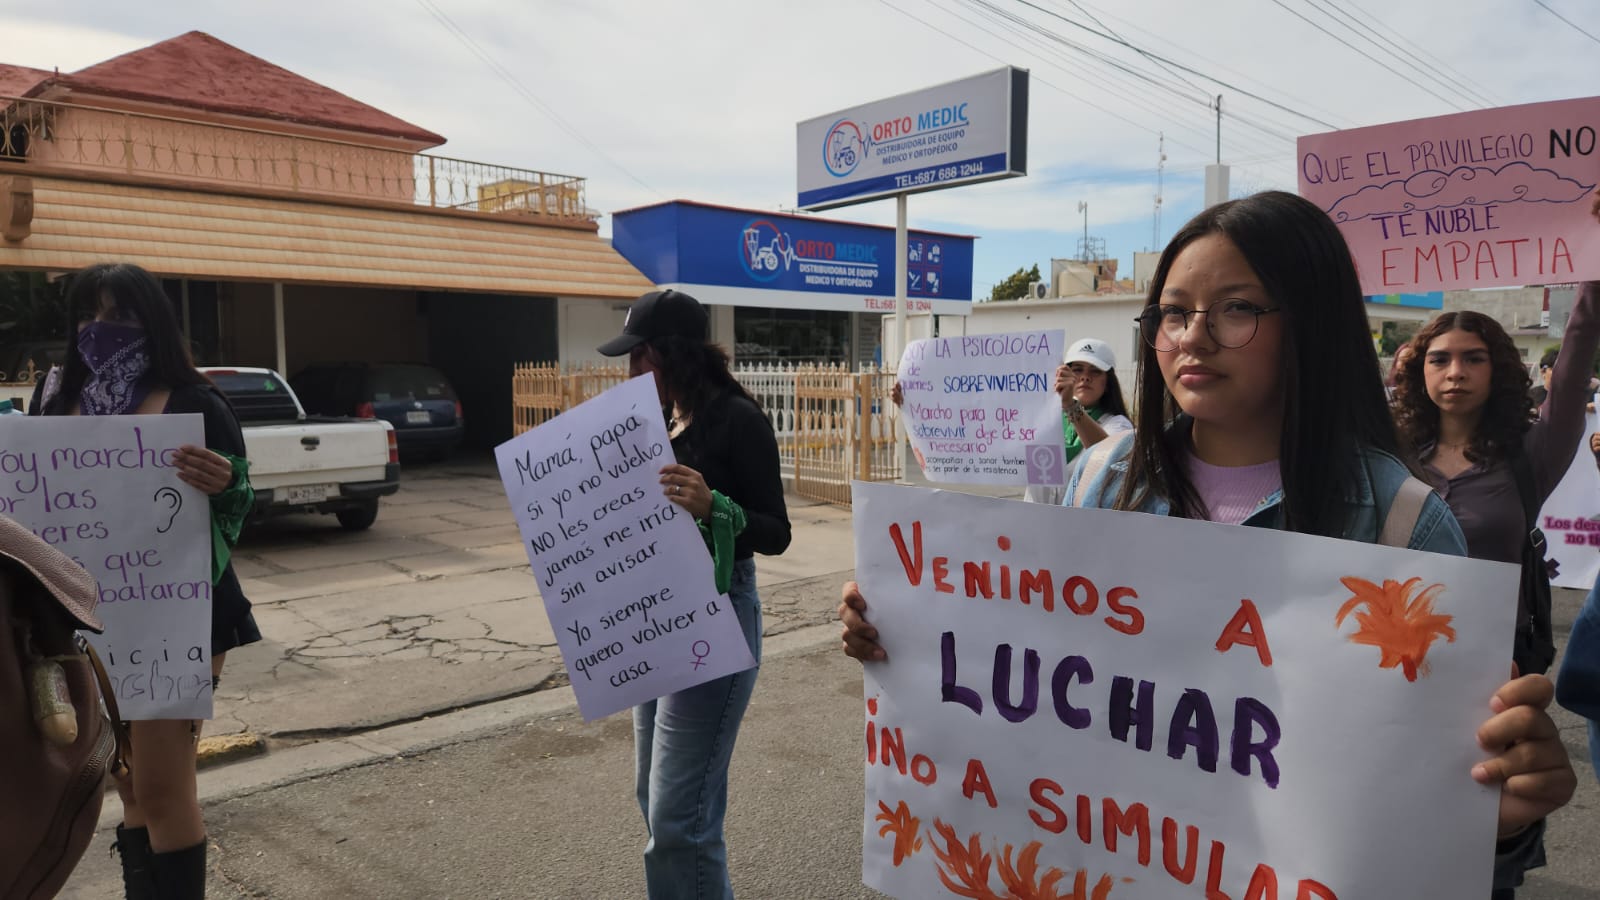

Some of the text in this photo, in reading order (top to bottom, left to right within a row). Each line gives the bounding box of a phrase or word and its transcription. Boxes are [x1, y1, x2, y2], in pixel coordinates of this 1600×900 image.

[873, 103, 969, 141] ORTO MEDIC
[876, 129, 965, 156] DISTRIBUIDORA DE EQUIPO
[1303, 126, 1597, 184] QUE EL PRIVILEGIO NO
[894, 161, 983, 187] TEL:687 688 1244
[1371, 205, 1501, 240] TE NUBLE
[1382, 237, 1574, 286] EMPATIA
[935, 338, 952, 358] LA
[943, 373, 1048, 394] SOBREVIVIERON
[960, 408, 986, 425] para
[995, 407, 1019, 426] que
[1002, 423, 1016, 440] de
[1019, 427, 1036, 441] ser
[590, 403, 642, 472] papá
[929, 441, 988, 454] necesario
[0, 449, 38, 493] oy
[578, 475, 601, 495] no
[607, 443, 663, 479] vuelvo
[42, 476, 97, 512] las
[531, 486, 646, 555] NO les creas
[603, 526, 632, 548] me
[1544, 515, 1571, 530] Los
[1565, 533, 1586, 545] no
[104, 546, 162, 583] que
[97, 573, 210, 603] bataron
[560, 581, 586, 604] sin
[567, 587, 674, 646] Yo siempre
[1214, 598, 1274, 667] A
[575, 600, 721, 681] quiero volver a
[940, 631, 1282, 789] LUCHAR
[961, 758, 1000, 809] A
